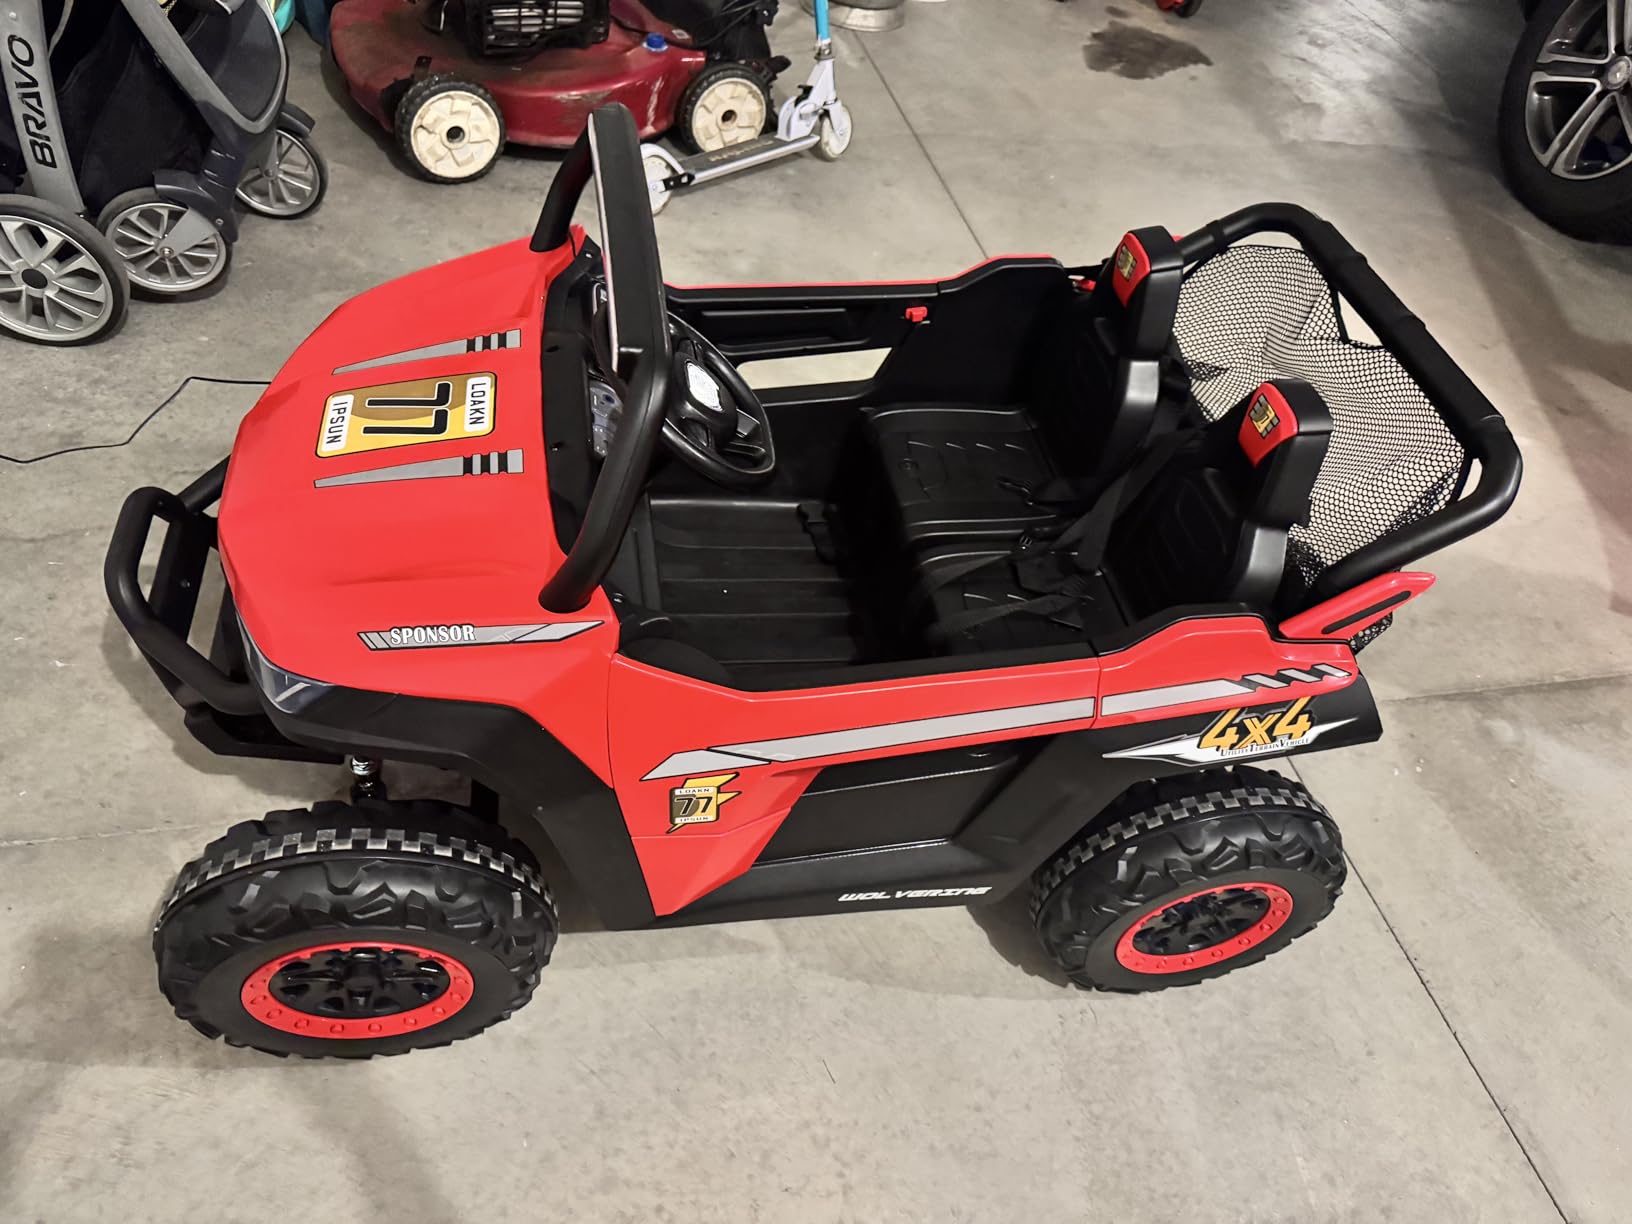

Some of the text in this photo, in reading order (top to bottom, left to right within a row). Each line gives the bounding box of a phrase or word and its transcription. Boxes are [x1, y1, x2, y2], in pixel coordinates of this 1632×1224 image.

[7, 34, 58, 169] BRAVO
[326, 401, 348, 444] IPSUN
[469, 382, 487, 426] LOAKN
[390, 624, 476, 645] SPONSOR
[674, 796, 713, 815] 77
